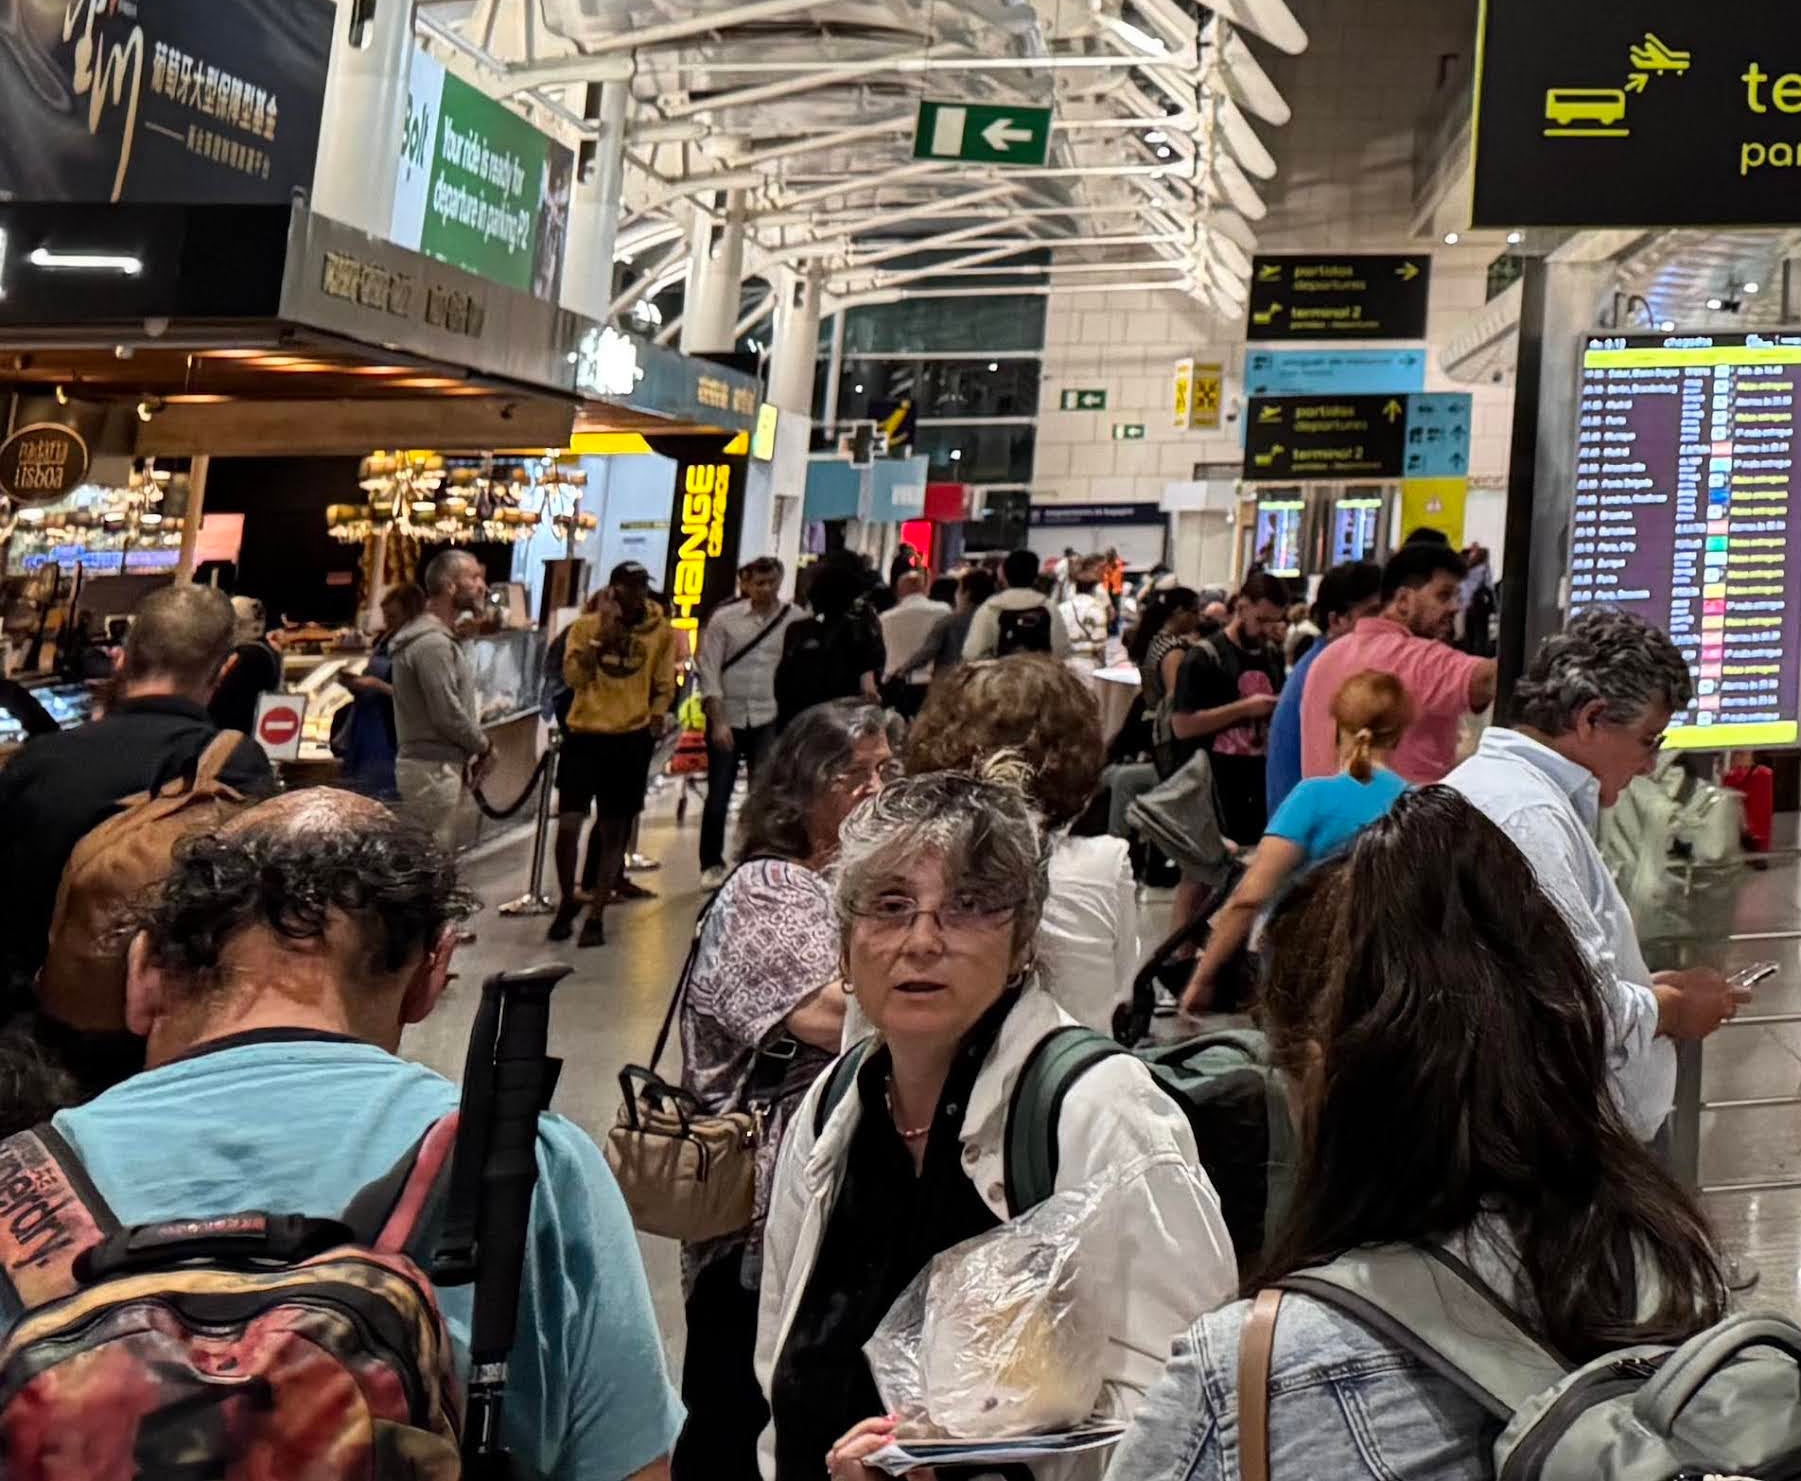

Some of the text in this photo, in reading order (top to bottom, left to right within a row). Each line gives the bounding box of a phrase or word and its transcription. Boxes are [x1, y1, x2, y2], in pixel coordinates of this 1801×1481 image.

[442, 115, 526, 200] Your ride is ready for
[433, 170, 478, 228] departure
[478, 189, 486, 232] in
[484, 203, 518, 255] parking
